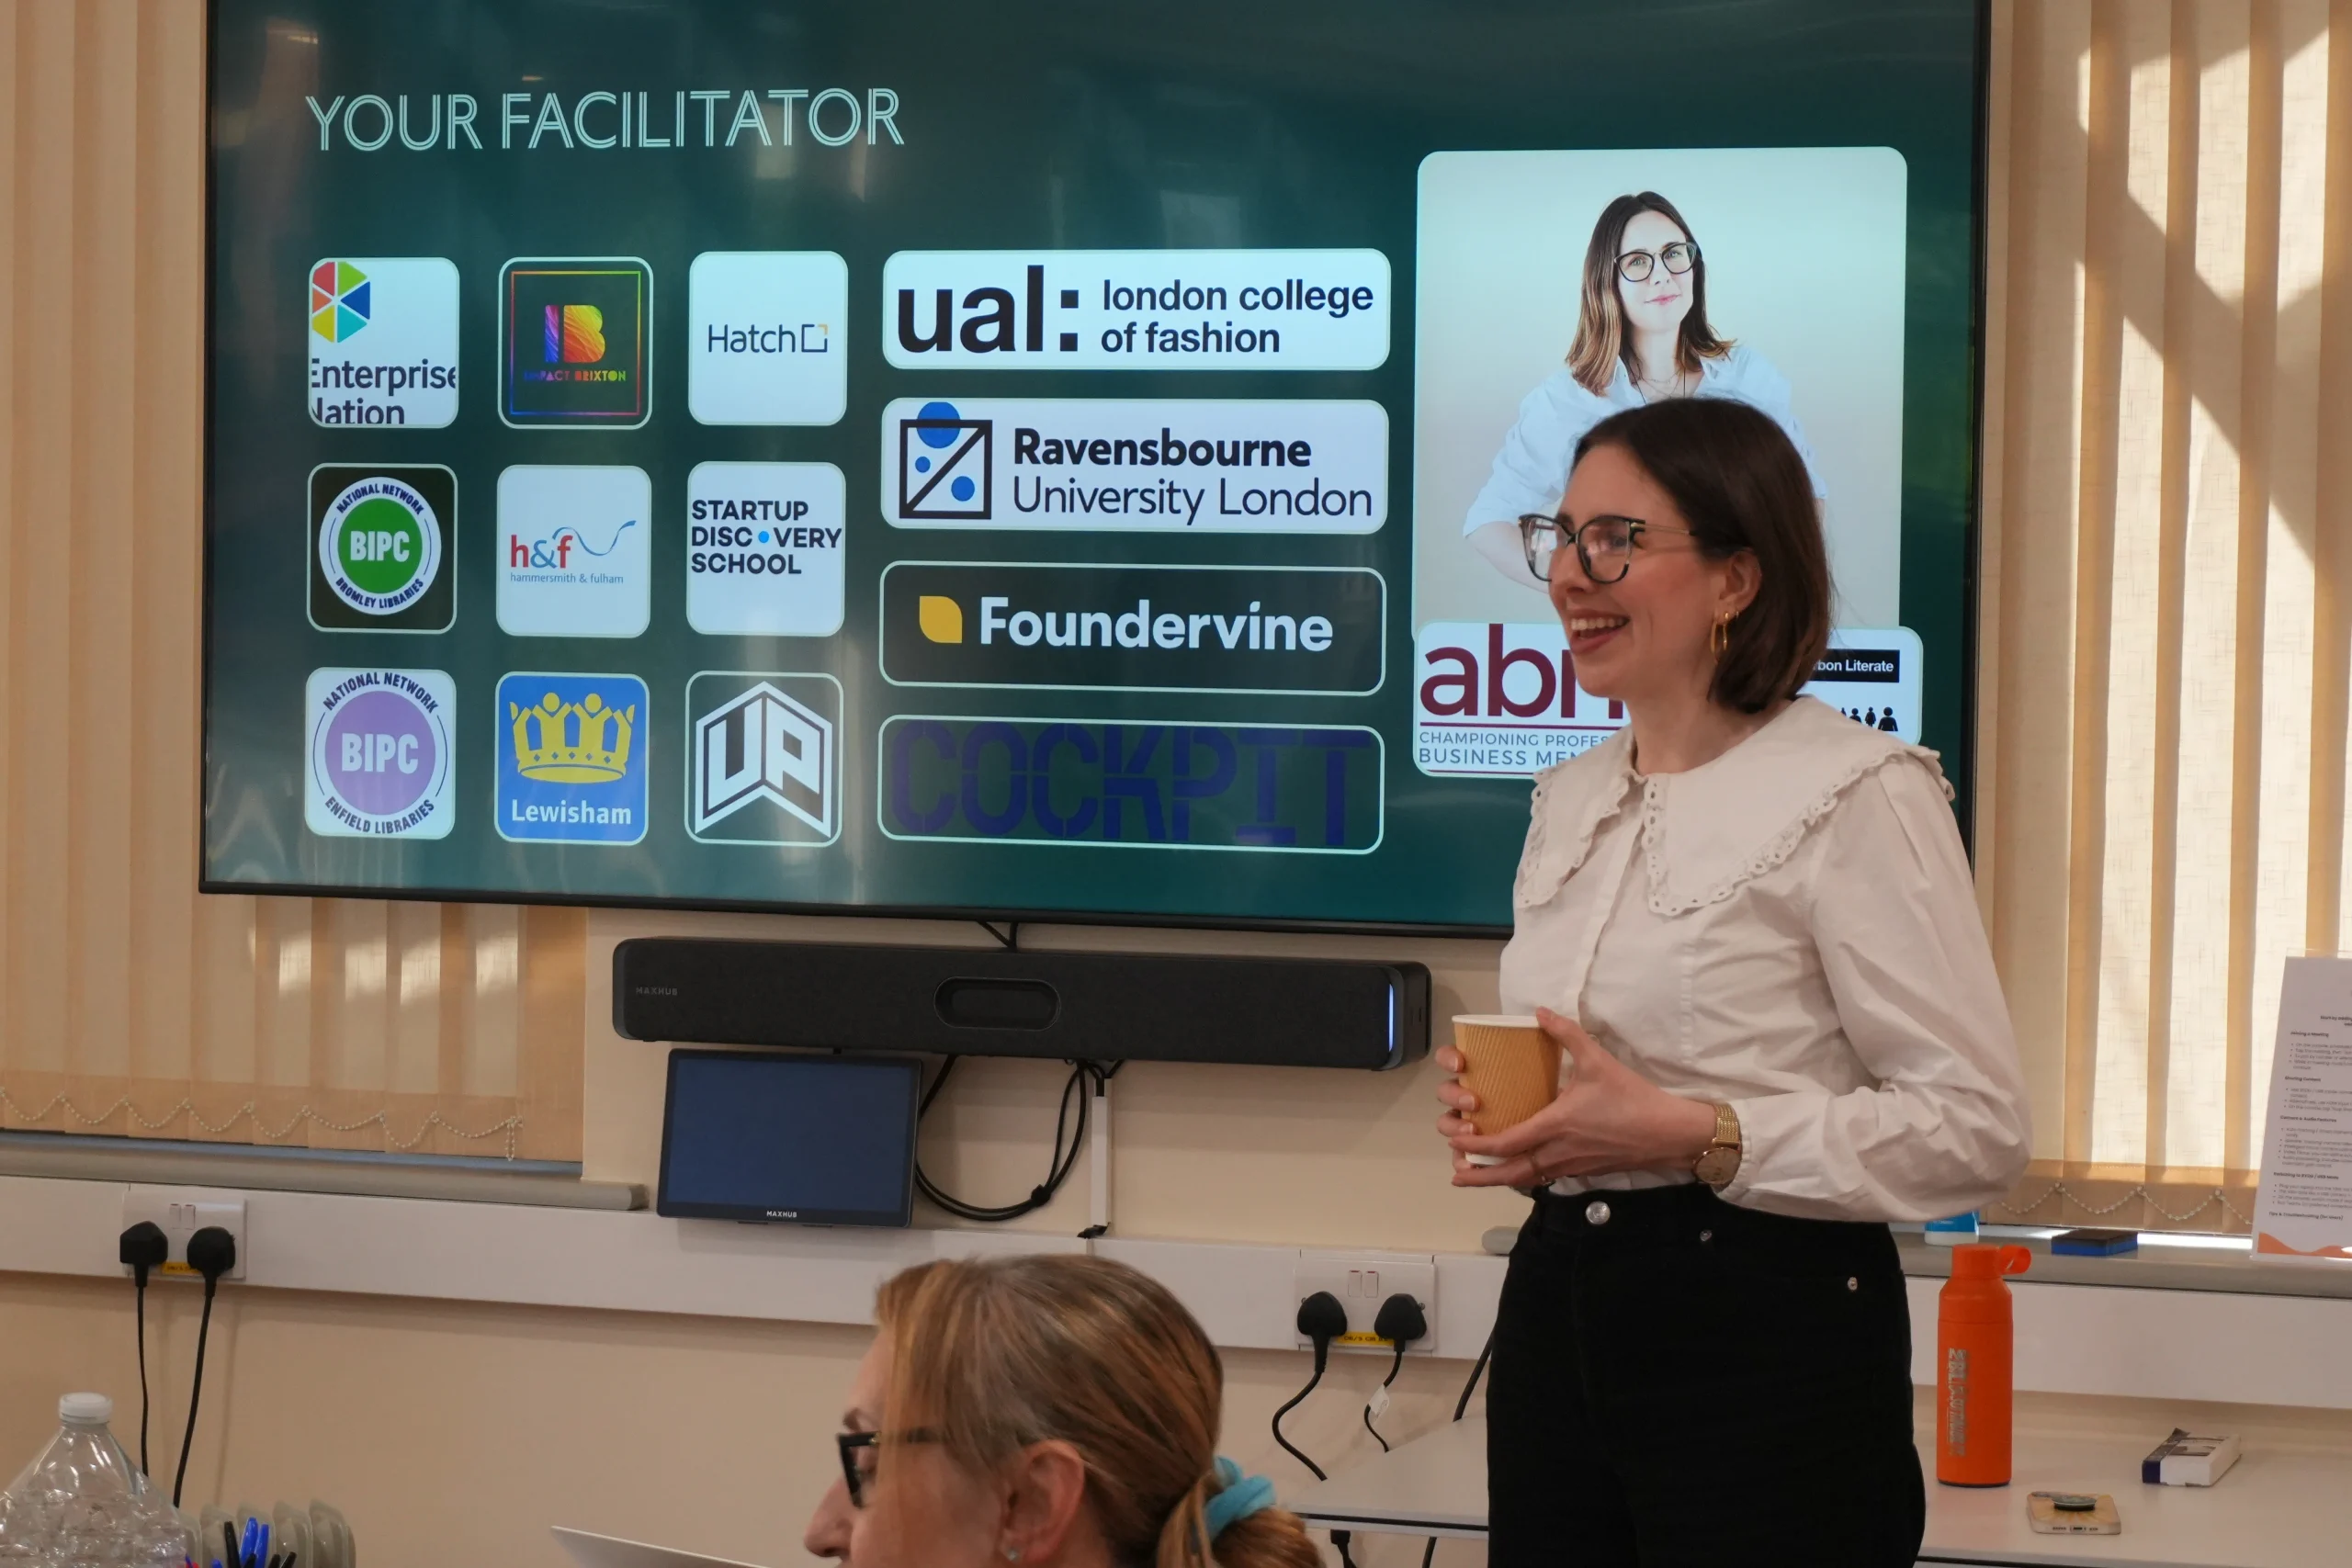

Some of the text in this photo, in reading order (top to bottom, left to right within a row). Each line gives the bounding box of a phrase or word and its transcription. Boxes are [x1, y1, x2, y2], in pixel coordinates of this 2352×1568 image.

[305, 87, 905, 152] YOUR FACILITATOR
[898, 264, 1080, 354] ual:
[1102, 279, 1374, 318] london college
[708, 324, 796, 353] Hatch
[1101, 321, 1280, 354] of fashion
[575, 370, 627, 381] BRIXTON
[1014, 428, 1312, 468] Ravensbourne
[336, 483, 424, 515] NATIONAL NETWORK
[692, 499, 808, 521] STARTUP
[1013, 476, 1373, 526] University London
[350, 530, 410, 562] BIPC
[511, 534, 573, 569] h&f
[510, 572, 624, 583] hammersmith & fulham
[691, 552, 802, 574] SCHOOL
[335, 577, 424, 609] BROMLEY LIBRARIES
[980, 596, 1334, 651] Foundervine
[1813, 660, 1894, 672] bon Literate
[323, 671, 438, 714] NATIONAL NETWORK
[342, 732, 419, 774] BIPC
[1419, 731, 1539, 746] CHAMPIONING
[1419, 748, 1577, 766] BUSINESS ME
[891, 720, 1372, 846] COCKPIT
[324, 795, 435, 835] ENFIELD LIBRARIES
[512, 799, 631, 824] Lewisham
[636, 987, 678, 995] MAXHUB
[766, 1210, 797, 1218] MAXHUB
